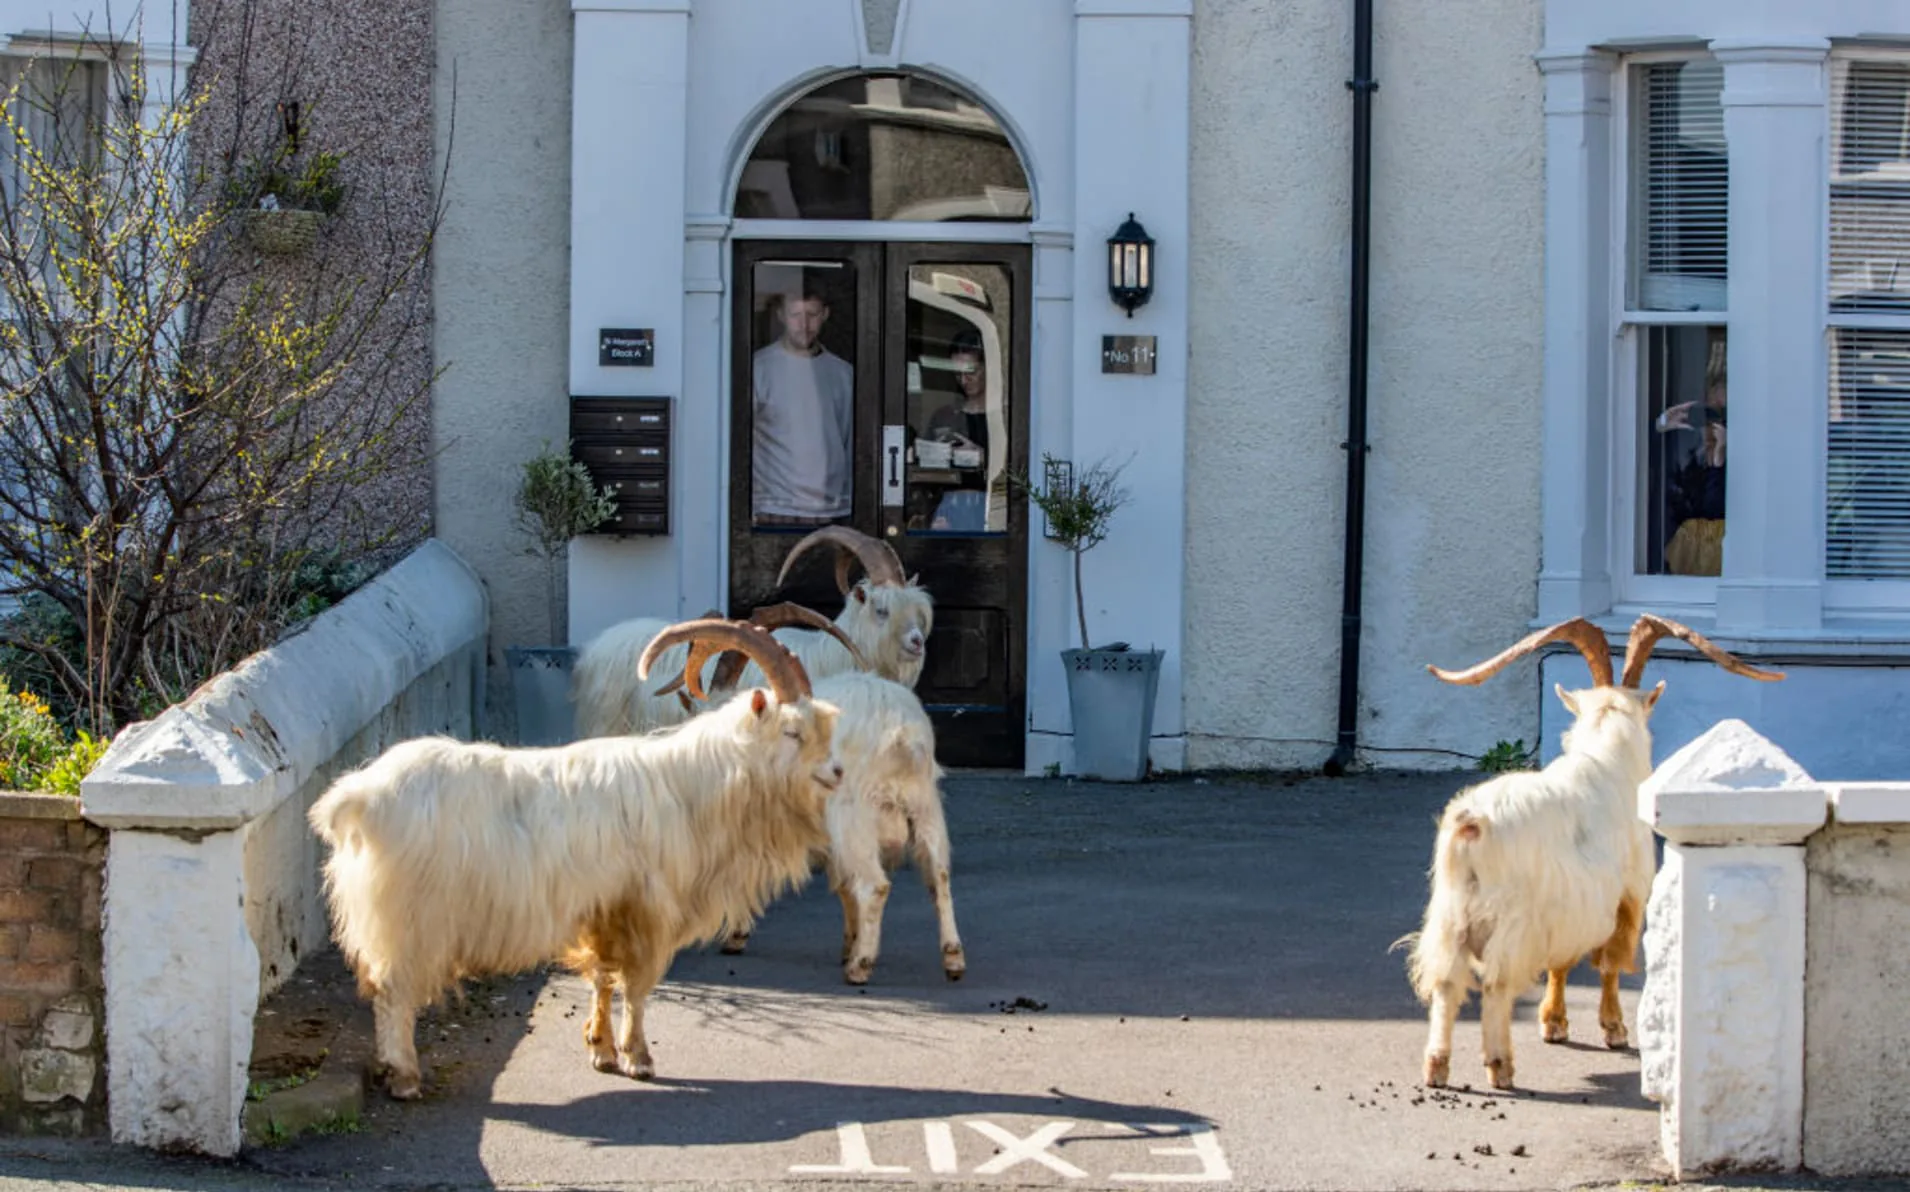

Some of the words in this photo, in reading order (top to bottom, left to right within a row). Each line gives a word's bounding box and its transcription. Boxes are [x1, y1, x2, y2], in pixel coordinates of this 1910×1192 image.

[1110, 350, 1128, 364] No
[1131, 345, 1148, 364] 11
[788, 1121, 1233, 1182] EXIT
